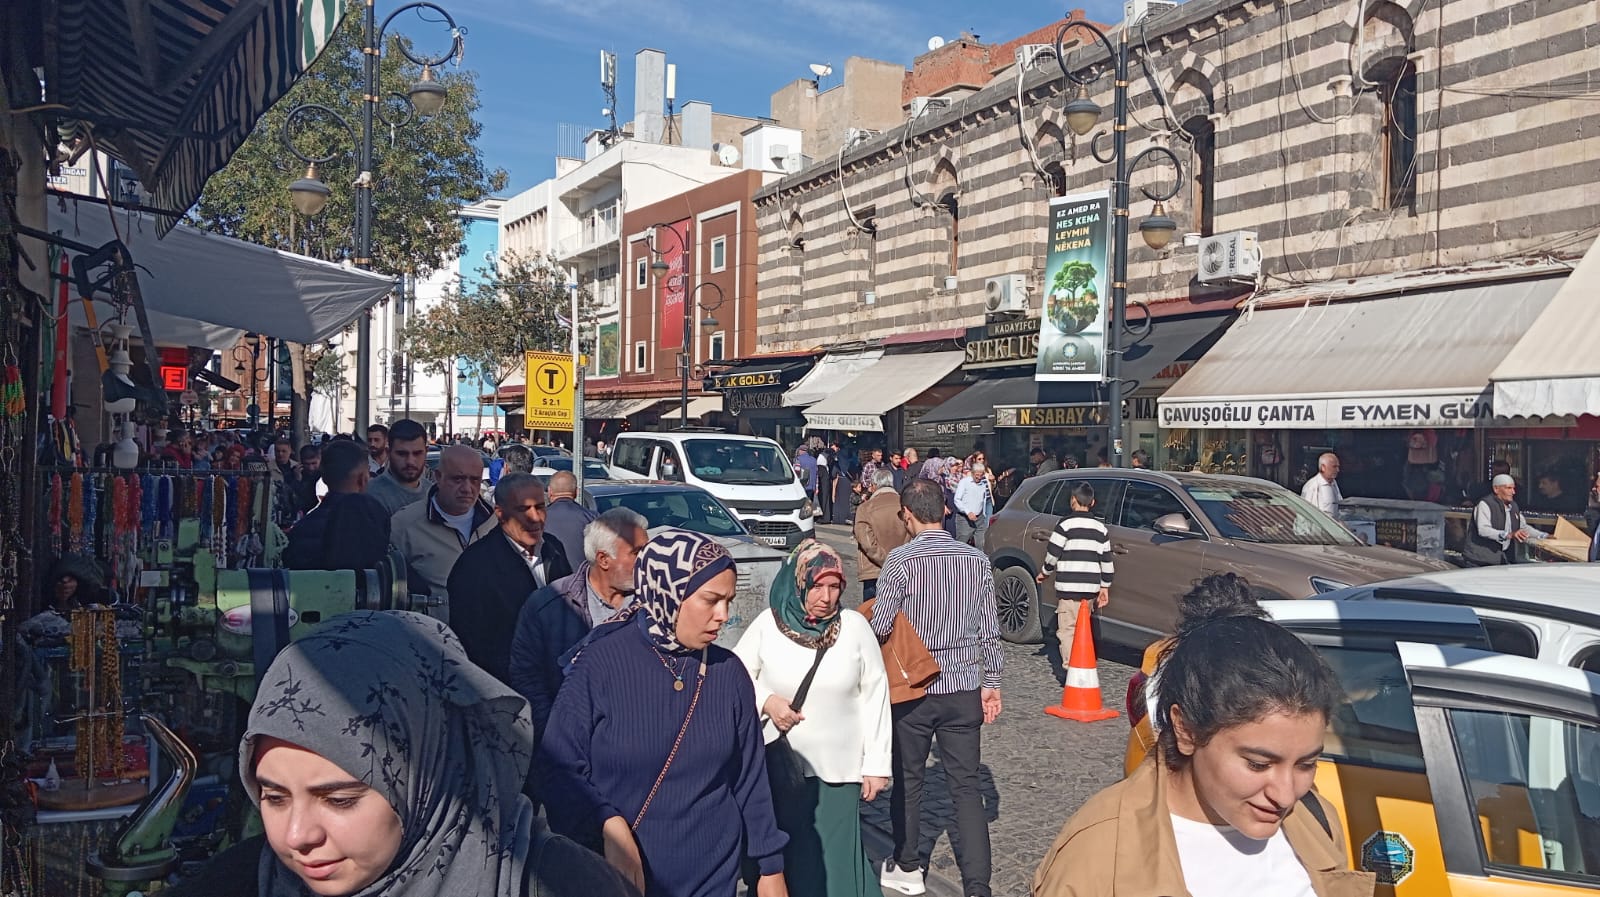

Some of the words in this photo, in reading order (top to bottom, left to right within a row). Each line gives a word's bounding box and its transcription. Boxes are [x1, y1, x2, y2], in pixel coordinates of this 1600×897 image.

[1068, 206, 1088, 215] AMED
[1075, 213, 1099, 225] KENA
[739, 375, 765, 386] GOLD
[1163, 403, 1252, 426] ÇAVUŞOĞLU
[1257, 405, 1315, 426] ÇANTA
[1341, 404, 1430, 421] EYMEN
[938, 424, 955, 434] SINCE
[956, 422, 968, 433] 1968
